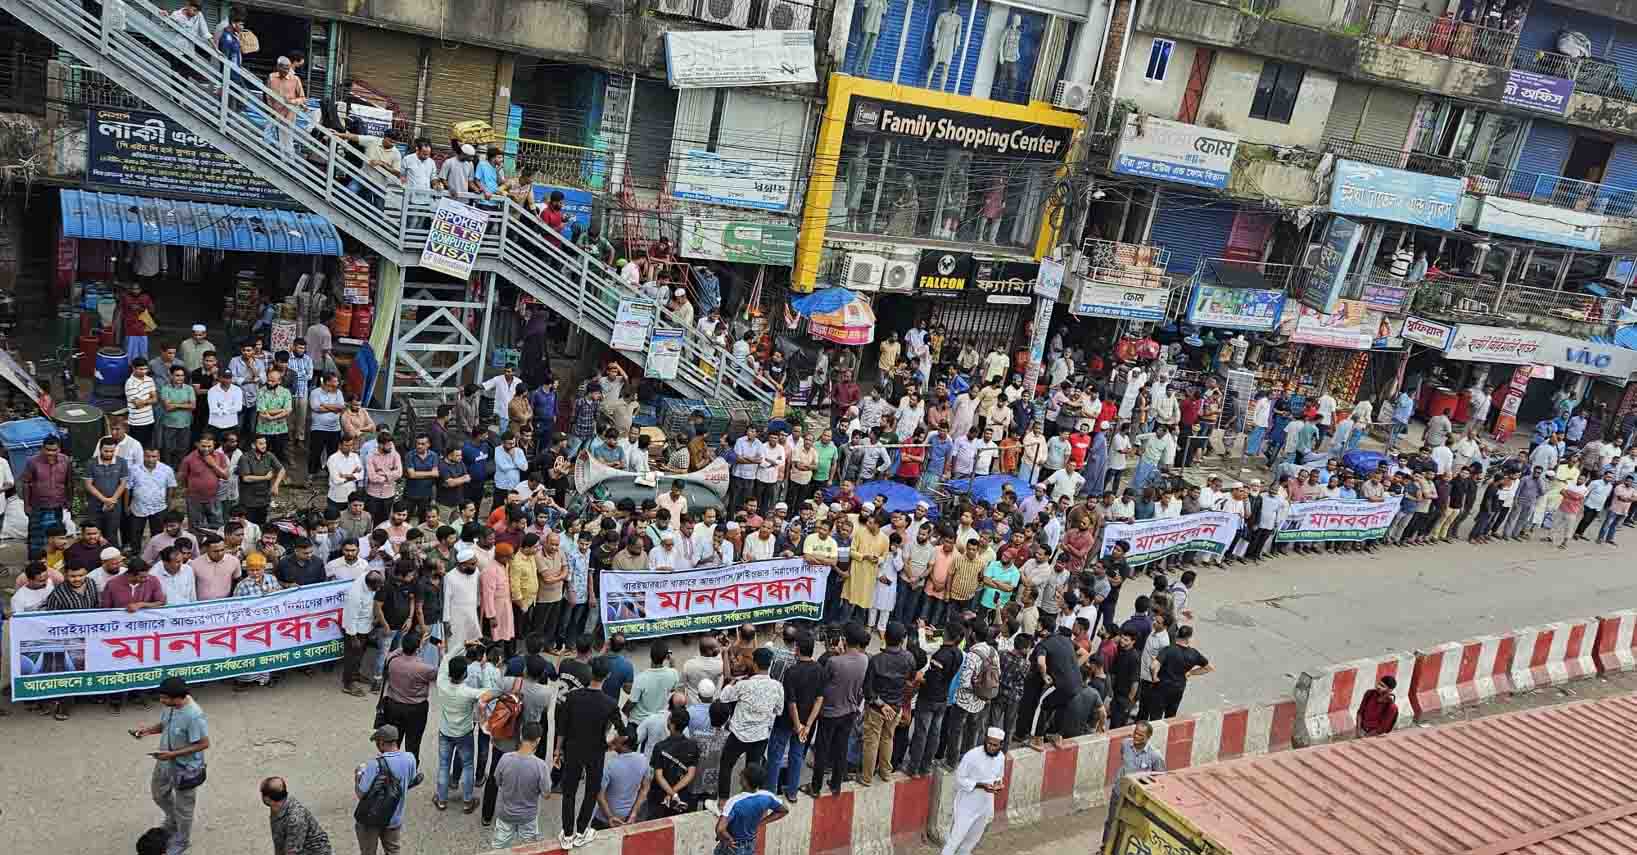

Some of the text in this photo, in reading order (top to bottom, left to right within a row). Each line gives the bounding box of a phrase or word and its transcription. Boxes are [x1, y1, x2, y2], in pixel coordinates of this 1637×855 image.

[1521, 88, 1564, 104] অফিস
[98, 119, 166, 144] লাকী
[881, 109, 1060, 154] Family Shopping Center
[1194, 137, 1236, 157] ফোম
[434, 219, 481, 242] IELTS
[438, 209, 484, 233] SPOKEN
[431, 231, 477, 253] COMPUTER
[431, 242, 471, 263] VISA
[920, 276, 966, 290] FALCON
[976, 277, 1037, 294] ফ্যামি
[656, 577, 817, 612] মানববন্ধন
[48, 621, 120, 637] বারইয়ারহাট
[125, 617, 165, 633] বাজারে
[101, 607, 344, 663] মানববন্ধন
[23, 676, 82, 692] আয়োজনে
[96, 669, 164, 687] বারইয়ারহাট
[166, 662, 210, 679] বাজারের
[214, 656, 256, 673] সর্বস্তরের
[259, 651, 289, 666] জনগণ
[293, 650, 301, 660] ও
